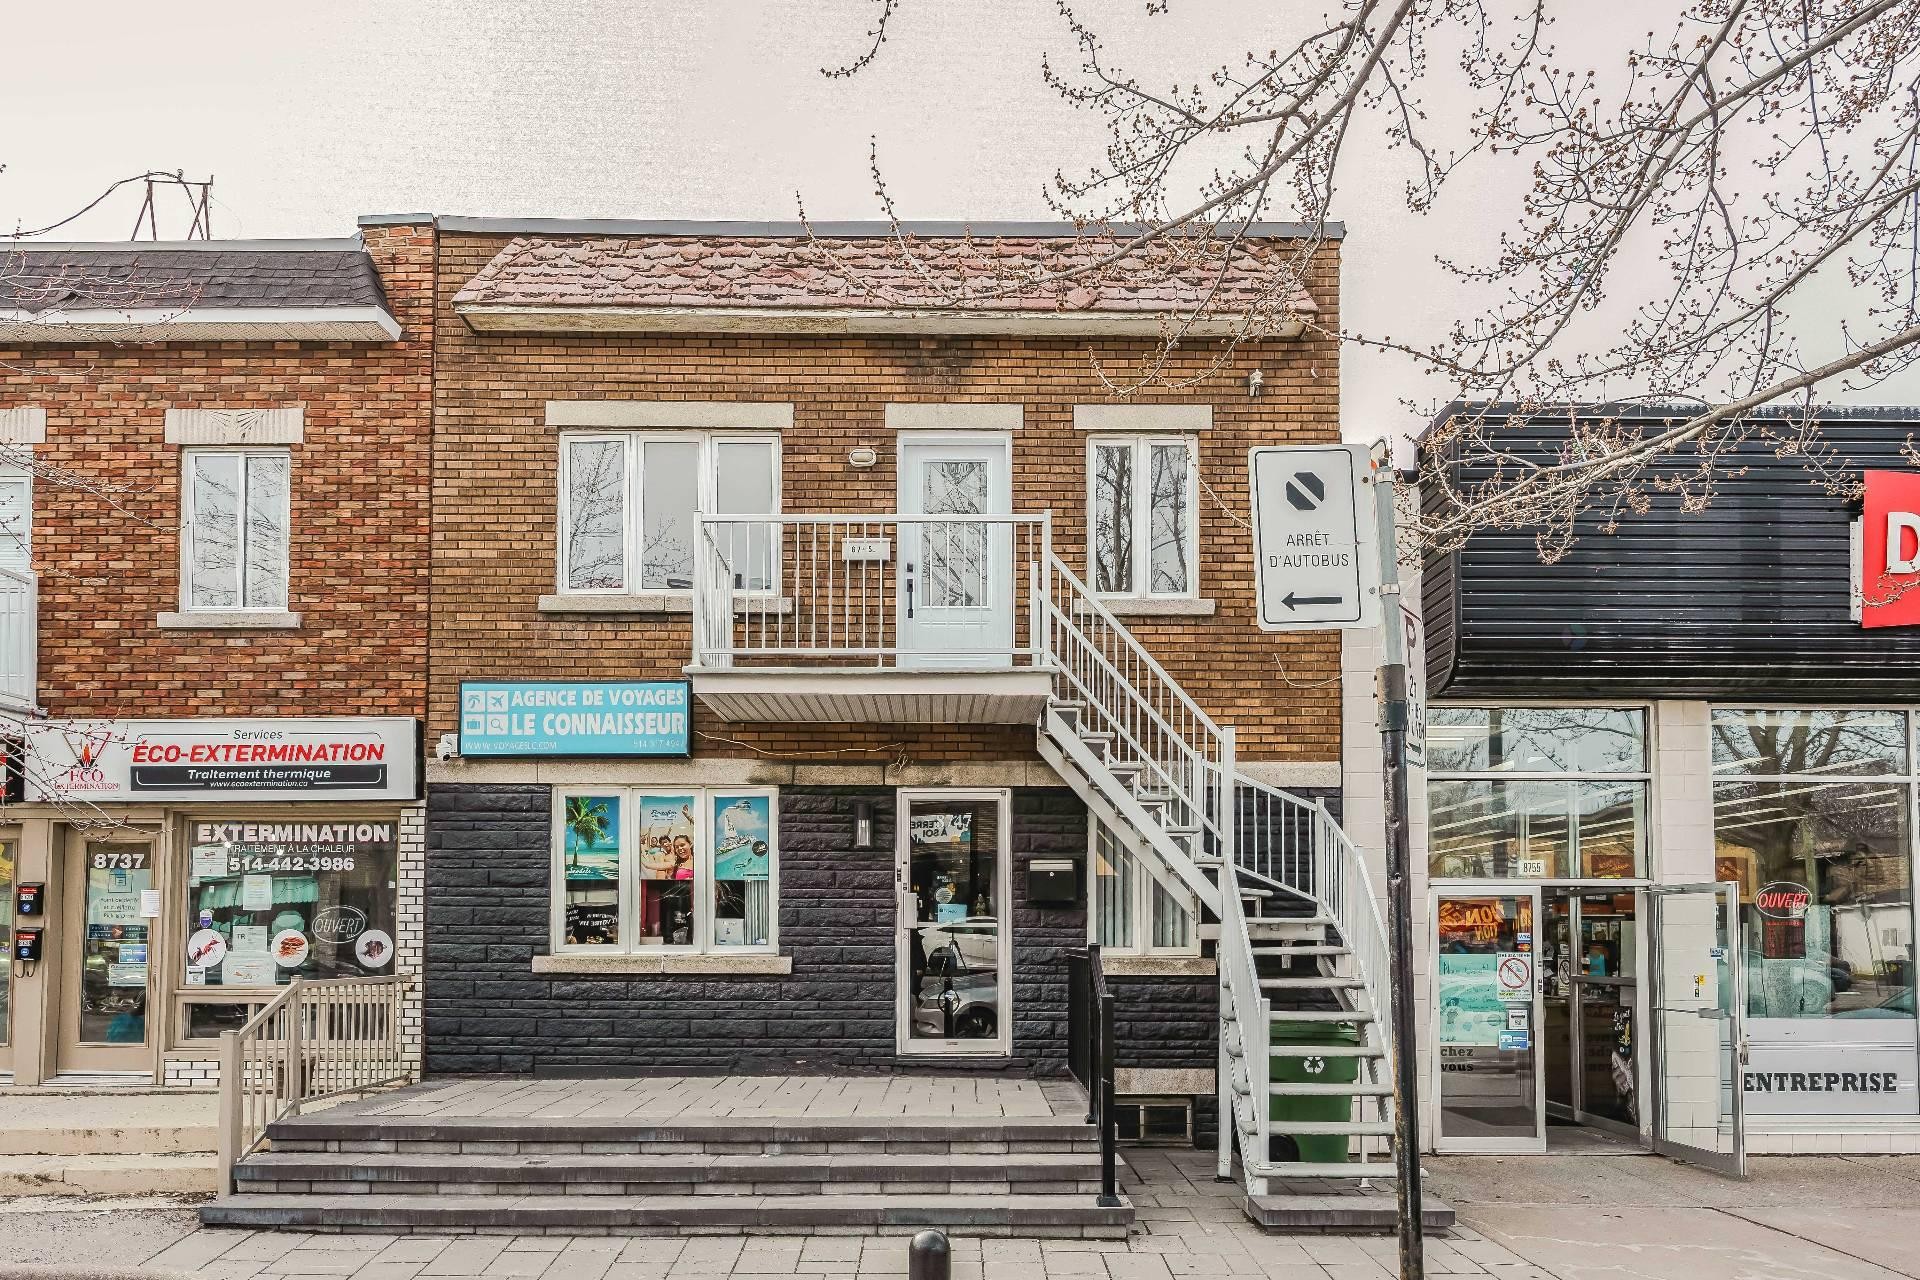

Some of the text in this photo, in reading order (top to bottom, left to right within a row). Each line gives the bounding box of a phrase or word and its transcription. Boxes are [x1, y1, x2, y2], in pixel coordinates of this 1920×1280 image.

[1286, 530, 1330, 546] ARRÊT
[1270, 553, 1349, 568] D'AUTOBUS
[511, 689, 684, 706] AGENCE DE VOYAGES
[511, 712, 685, 736] LE CONNAISSEUR
[233, 729, 283, 740] Services
[132, 739, 385, 763] ÉCO-EXTERMINATION
[70, 770, 104, 783] ECO
[187, 768, 332, 781] Traitement thermique
[197, 824, 390, 842] EXTERMINATION
[230, 842, 355, 853] TRAITEMENT À LA CHALEUR
[94, 853, 145, 869] 8737
[229, 857, 355, 871] 514-442-3986
[1523, 862, 1541, 873] 8755
[1758, 892, 1809, 909] OUVERT
[314, 917, 361, 933] OUVERT
[1440, 1046, 1474, 1057] chez
[1440, 1063, 1474, 1072] vous
[1743, 1072, 1897, 1092] ENTREPRISE
